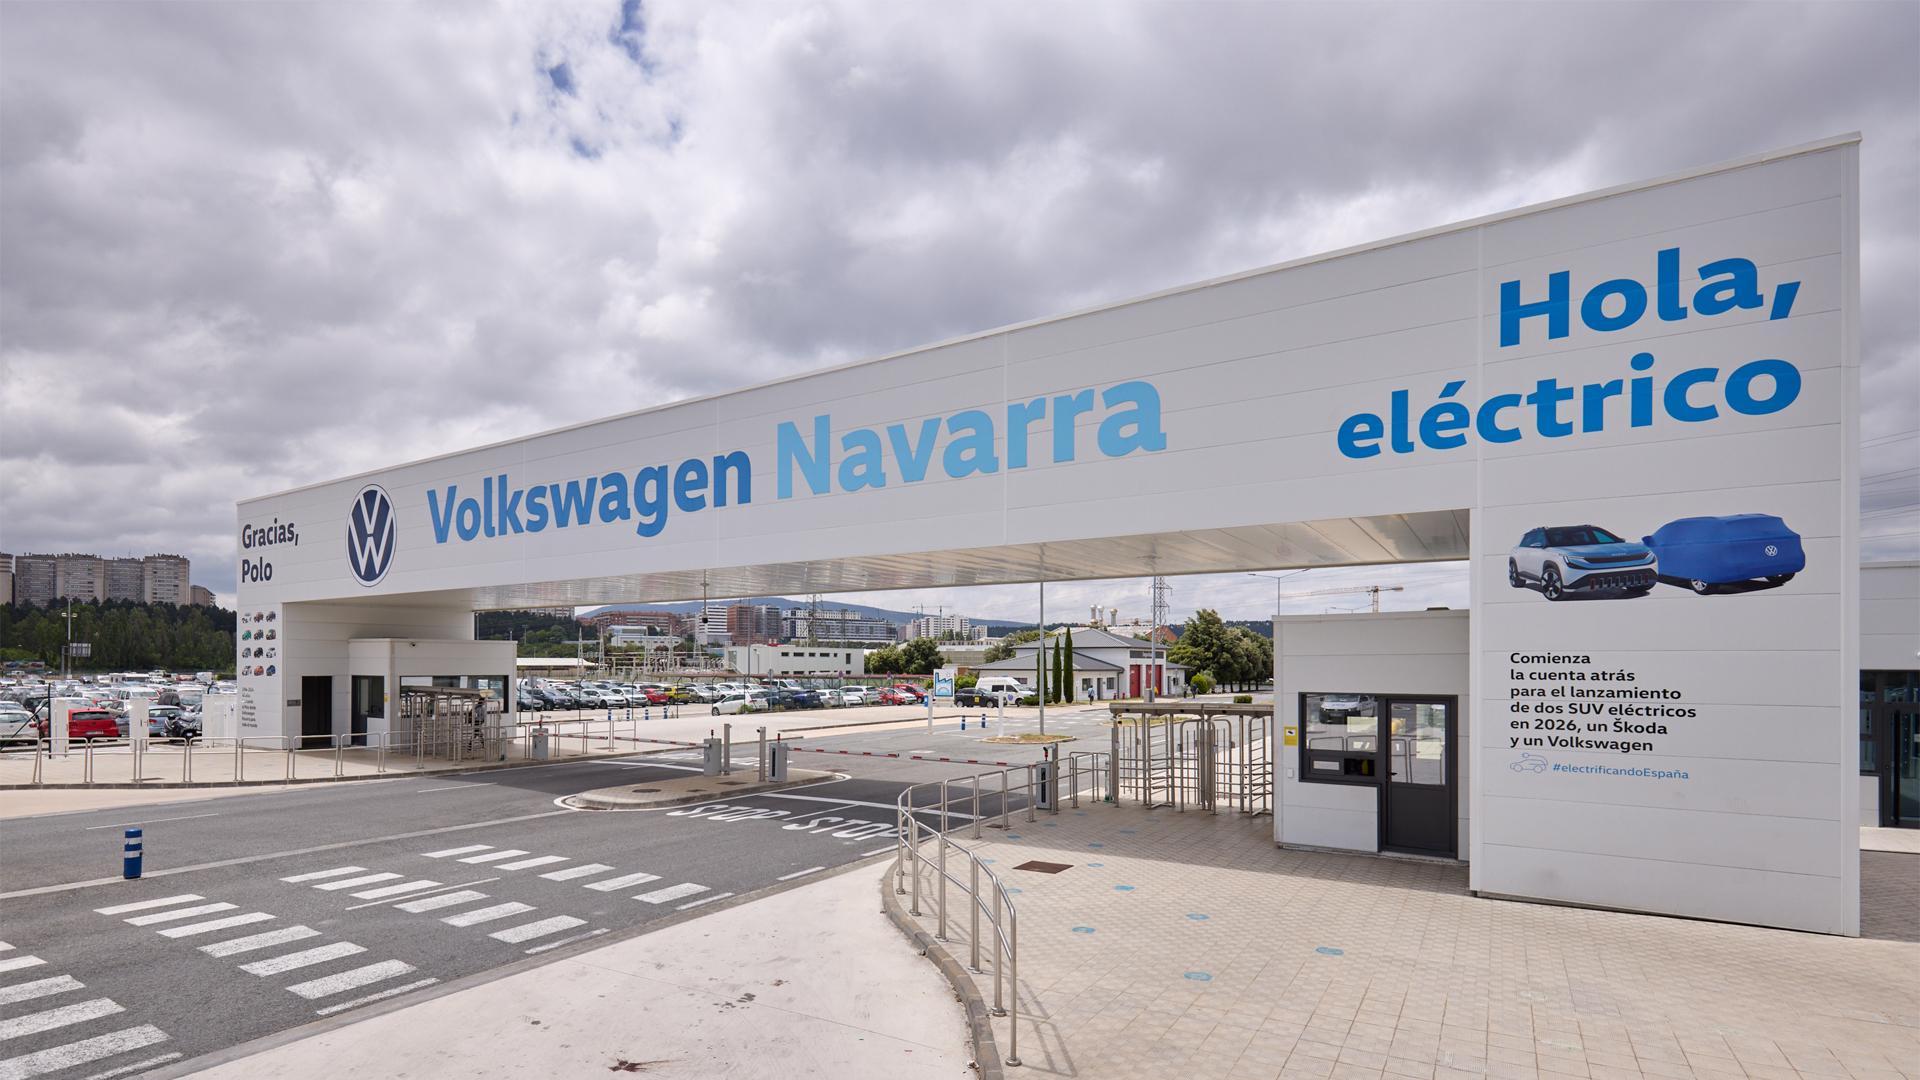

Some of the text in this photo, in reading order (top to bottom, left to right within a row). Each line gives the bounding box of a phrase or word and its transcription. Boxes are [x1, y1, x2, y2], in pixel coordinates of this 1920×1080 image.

[1499, 247, 1802, 348] Hola,
[1337, 352, 1802, 459] eléctrico
[426, 380, 1167, 544] Volkswagen Navarra
[242, 518, 299, 549] Gracias,
[347, 488, 396, 583] VW
[241, 556, 273, 583] Polo
[1510, 652, 1591, 664] Comienza
[1510, 668, 1635, 682] la cuenta atrás
[1510, 686, 1681, 700] para el lanzamiento
[1510, 702, 1697, 718] de dos SUV eléctricos
[1510, 718, 1668, 735] en 2026, un Škoda
[1510, 736, 1654, 753] y un Volkswagen
[1553, 764, 1689, 779] #electrificandoEspaña
[666, 804, 911, 841] STOP STOP
